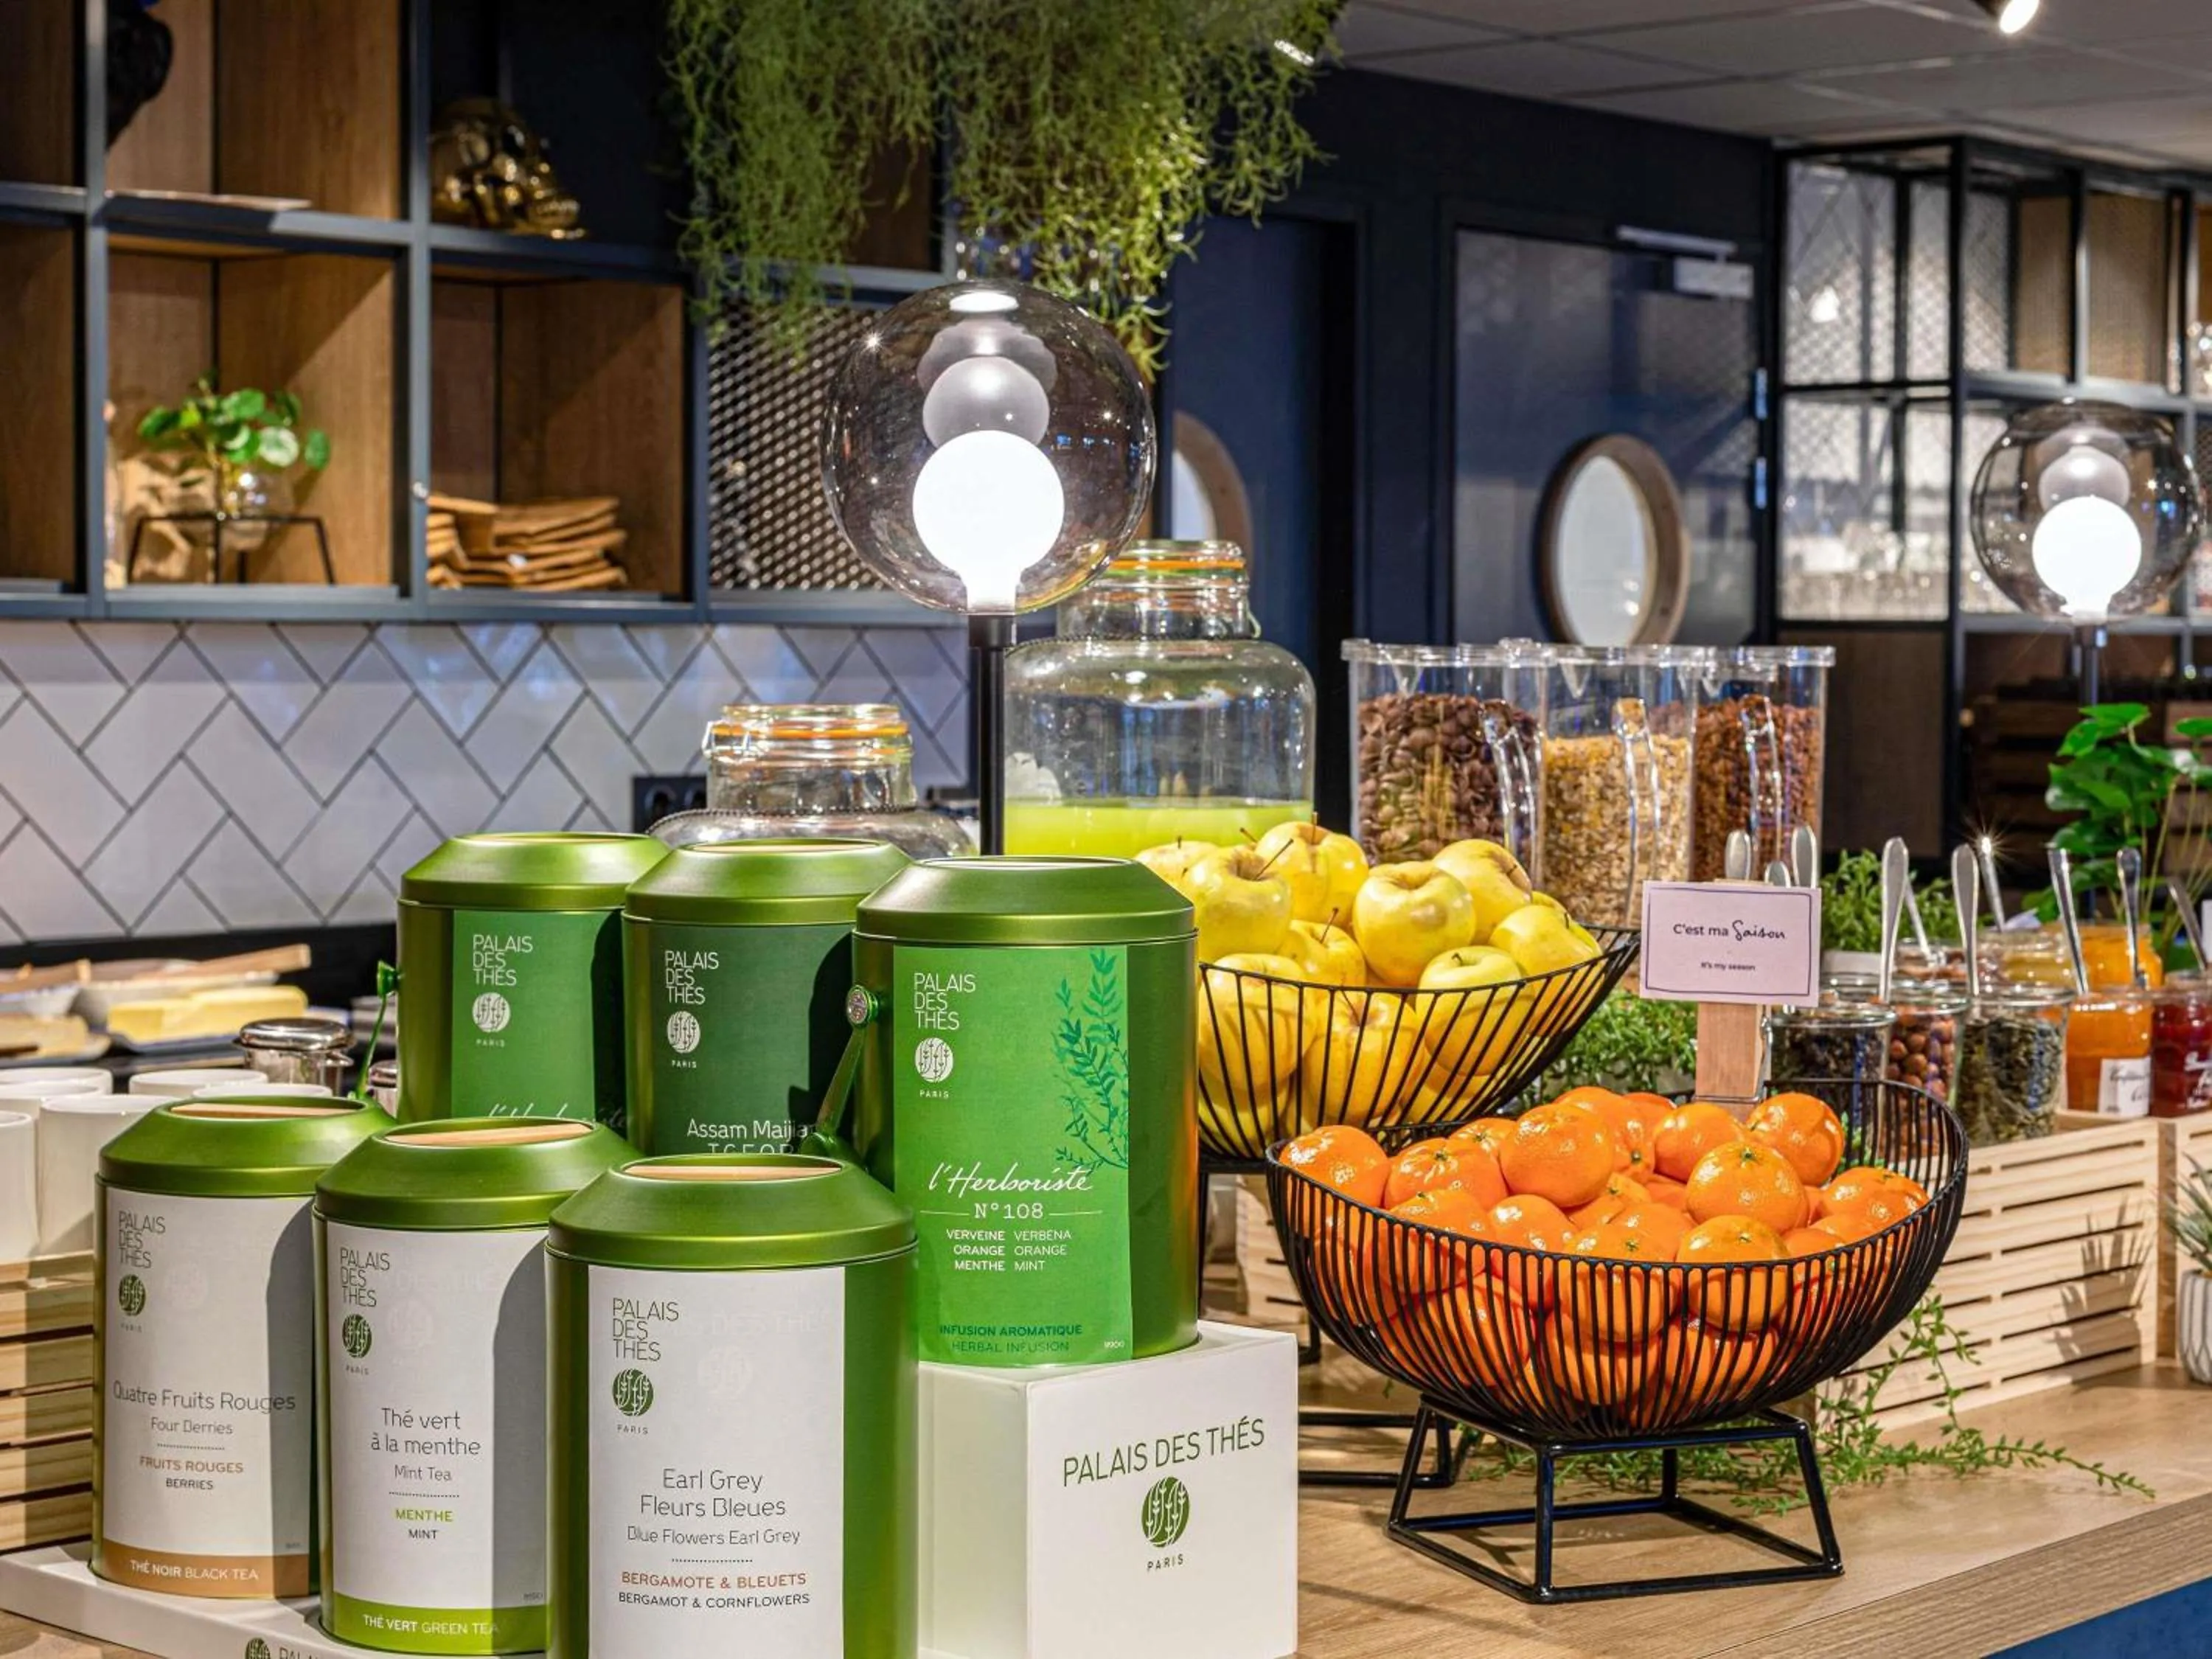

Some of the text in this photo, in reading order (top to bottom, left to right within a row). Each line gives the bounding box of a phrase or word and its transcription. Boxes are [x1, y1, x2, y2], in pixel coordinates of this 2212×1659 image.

[1673, 919, 1786, 942] C'est ma Saison
[473, 933, 534, 953] PALAIS
[473, 952, 506, 970] DES
[665, 950, 720, 970] PALAIS
[1714, 963, 1726, 971] my
[1728, 964, 1756, 972] season
[665, 968, 696, 987] DES
[914, 973, 976, 993] PALAIS
[914, 992, 948, 1011] DES
[672, 1060, 697, 1068] PARIS
[919, 1089, 950, 1099] PARIS
[686, 1117, 748, 1138] Assam
[928, 1161, 1093, 1198] l'Herboriste
[118, 1210, 166, 1234] PALAIS
[118, 1230, 144, 1251] DES
[946, 1229, 1073, 1241] VERVEINE VERBENA
[340, 1247, 391, 1271] PALAIS
[953, 1245, 1068, 1256] ORANGE ORANGE
[954, 1260, 1046, 1271] MENTHE MINT
[340, 1265, 367, 1288] DES
[613, 1297, 679, 1322] PALAIS
[613, 1318, 649, 1340] DES
[939, 1325, 1083, 1337] INFUSION AROMATIQUE
[952, 1340, 1070, 1352] HERBAL INFUSION
[112, 1380, 296, 1415] Quatre Fruits Rouges
[150, 1416, 180, 1432] Four
[380, 1408, 462, 1430] Thé vert
[616, 1424, 649, 1435] PARIS
[370, 1431, 481, 1455] à la menthe
[1063, 1415, 1266, 1487] PALAIS DES THÉS
[139, 1455, 244, 1474] FRUITS ROUGES
[394, 1464, 453, 1481] Mint Tea
[165, 1477, 214, 1491] BERRIES
[663, 1468, 763, 1494] Earl Grey
[640, 1494, 787, 1517] Fleurs Bleues
[394, 1509, 454, 1523] MENTHE
[408, 1528, 438, 1540] MINT
[627, 1526, 801, 1545] Blue Flowers Earl Grey
[152, 1563, 182, 1579] NOIR
[184, 1566, 228, 1580] BLACK
[233, 1568, 259, 1581] TEA
[1146, 1553, 1184, 1573] PARIS
[622, 1571, 807, 1590] BERGAMOTE & BLEUETS
[618, 1592, 811, 1609] BERGAMOT & CORNFLOWERS
[385, 1618, 418, 1633] VERT
[421, 1621, 468, 1635] GREEN
[470, 1622, 499, 1635] TEA
